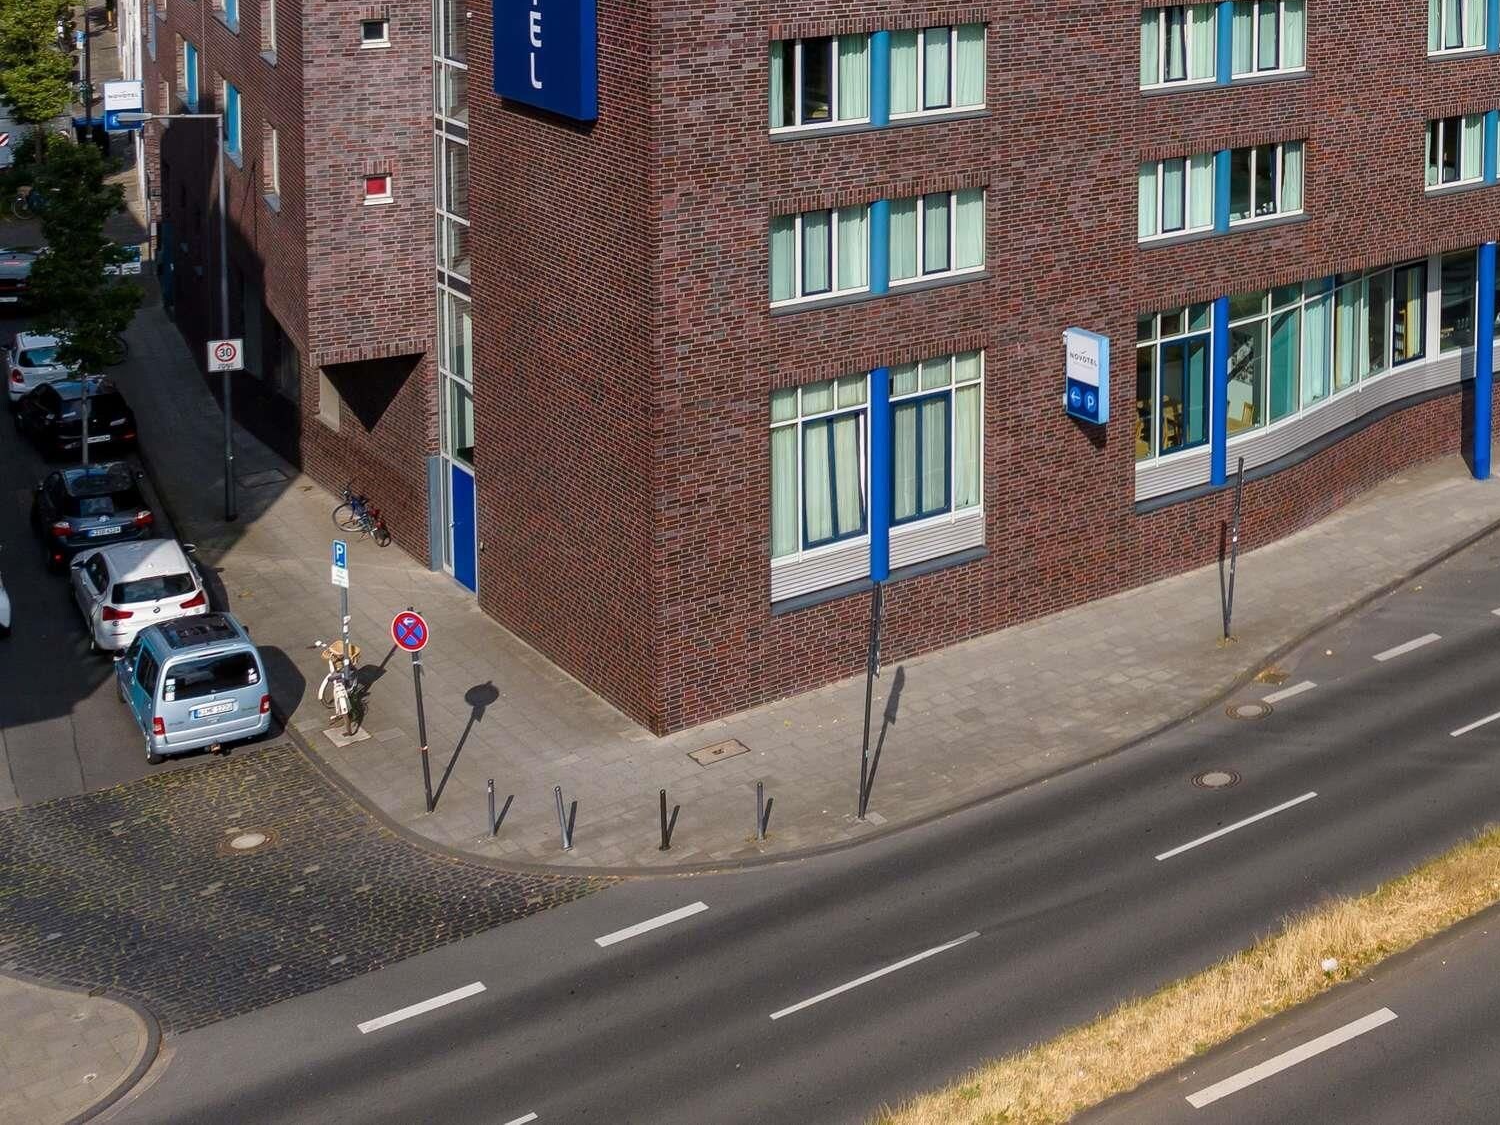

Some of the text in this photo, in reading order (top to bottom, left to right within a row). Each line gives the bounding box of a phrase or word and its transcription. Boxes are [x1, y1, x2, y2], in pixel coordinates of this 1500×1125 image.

[219, 348, 232, 358] 30
[1069, 352, 1098, 367] NOVOTEL
[1087, 395, 1095, 410] P
[336, 544, 344, 560] P
